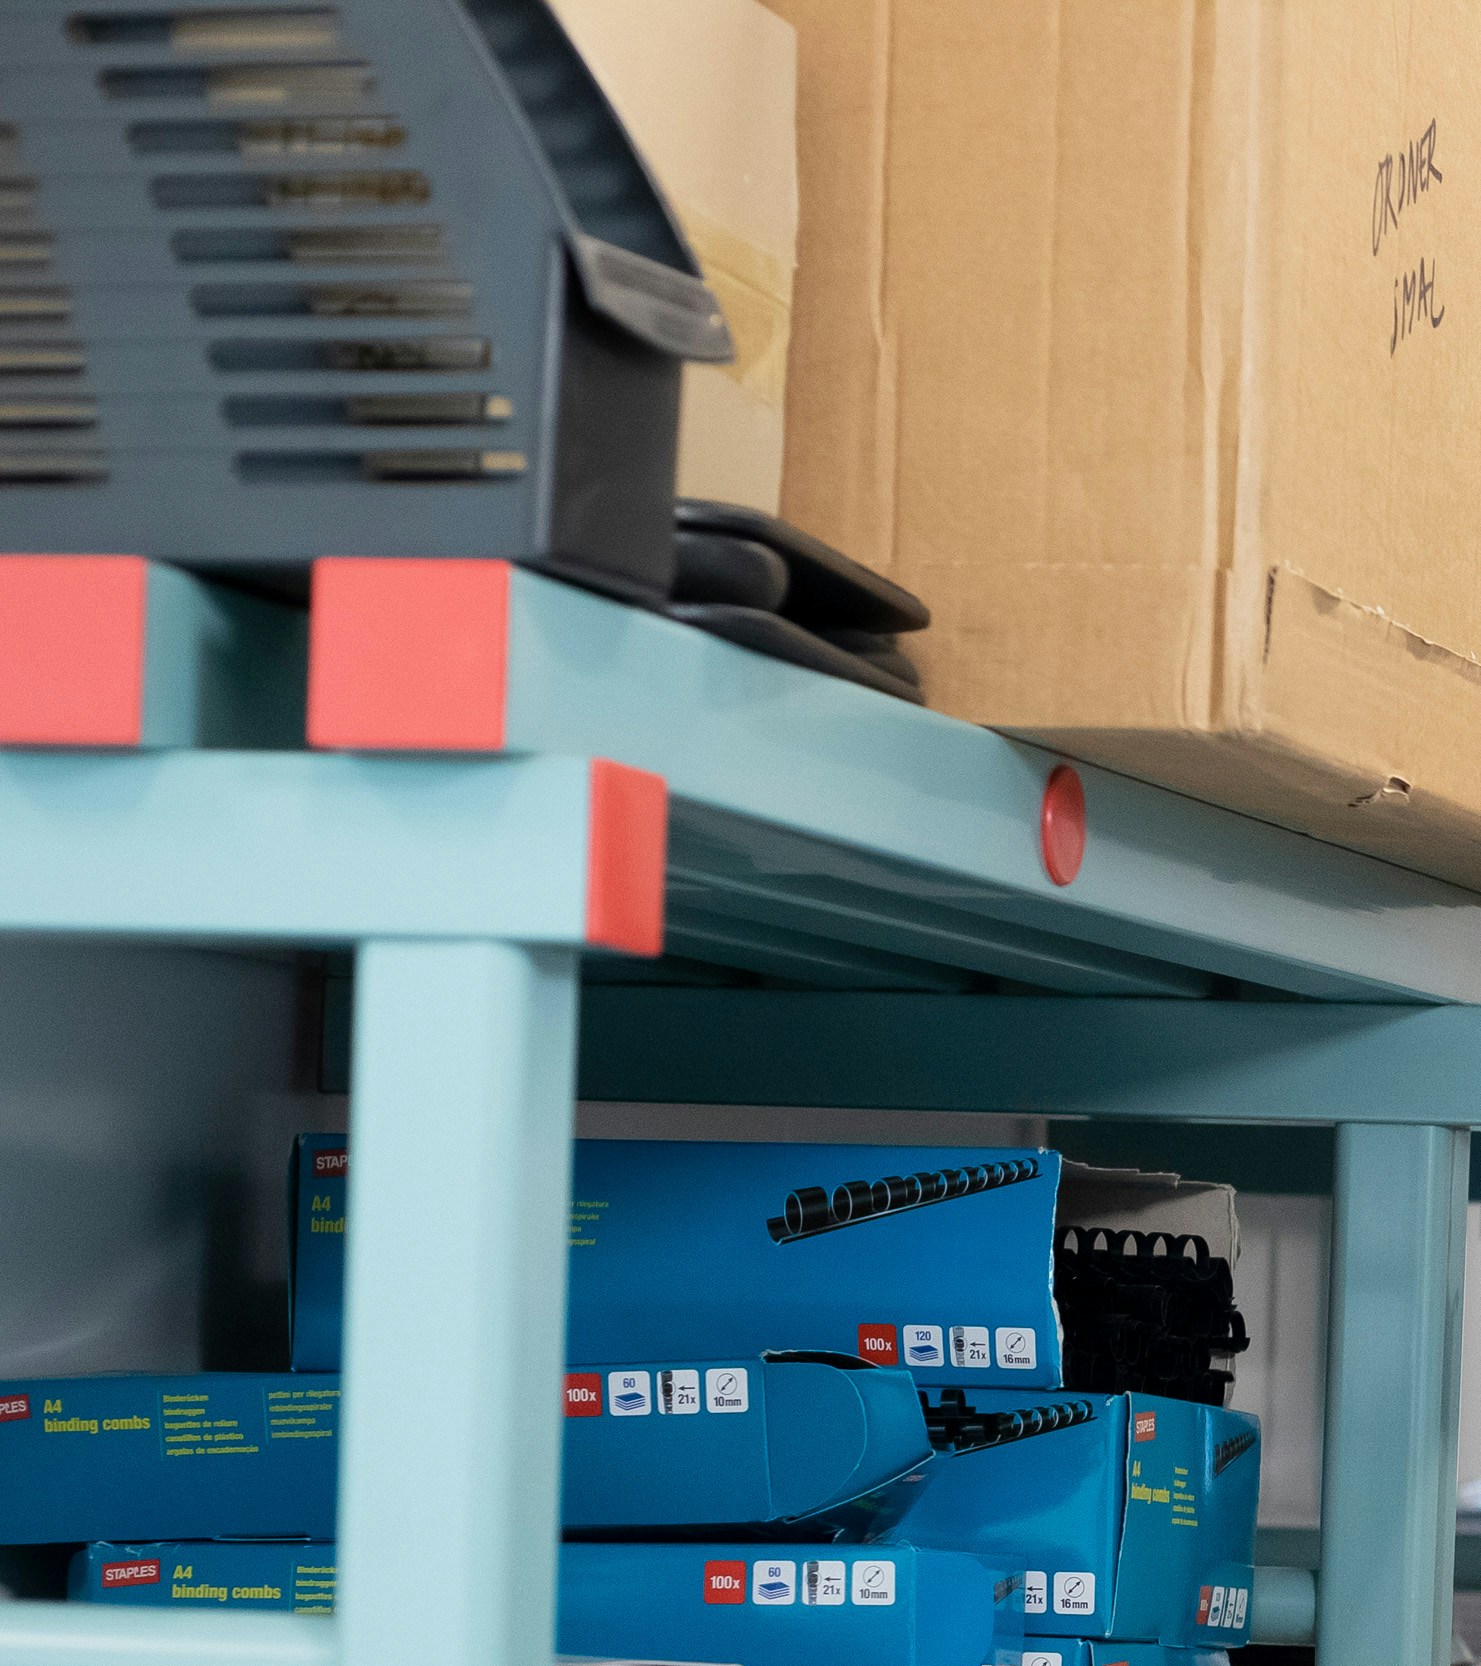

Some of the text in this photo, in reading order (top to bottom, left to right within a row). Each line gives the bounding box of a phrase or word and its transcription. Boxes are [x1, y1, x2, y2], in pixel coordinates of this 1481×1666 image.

[1372, 117, 1443, 257] ORDNER
[316, 1155, 348, 1170] STAP
[311, 1195, 331, 1211] A4
[311, 1216, 345, 1233] bind
[915, 1330, 931, 1341] 120
[864, 1337, 892, 1351] 100x
[969, 1349, 987, 1360] 21x
[622, 1377, 636, 1388] 60
[566, 1388, 596, 1402] 100x
[678, 1394, 696, 1404] 21x
[0, 1400, 26, 1414] PLES
[44, 1399, 62, 1414] A4
[44, 1415, 150, 1434] binding combs
[1136, 1418, 1155, 1434] STAPLES
[105, 1565, 157, 1581] STAPLES
[173, 1565, 193, 1579] A4
[768, 1566, 781, 1578] 60
[710, 1575, 740, 1589] 100x
[172, 1584, 281, 1602] binding combs
[823, 1584, 841, 1595] 21x
[1025, 1593, 1044, 1604] 21x
